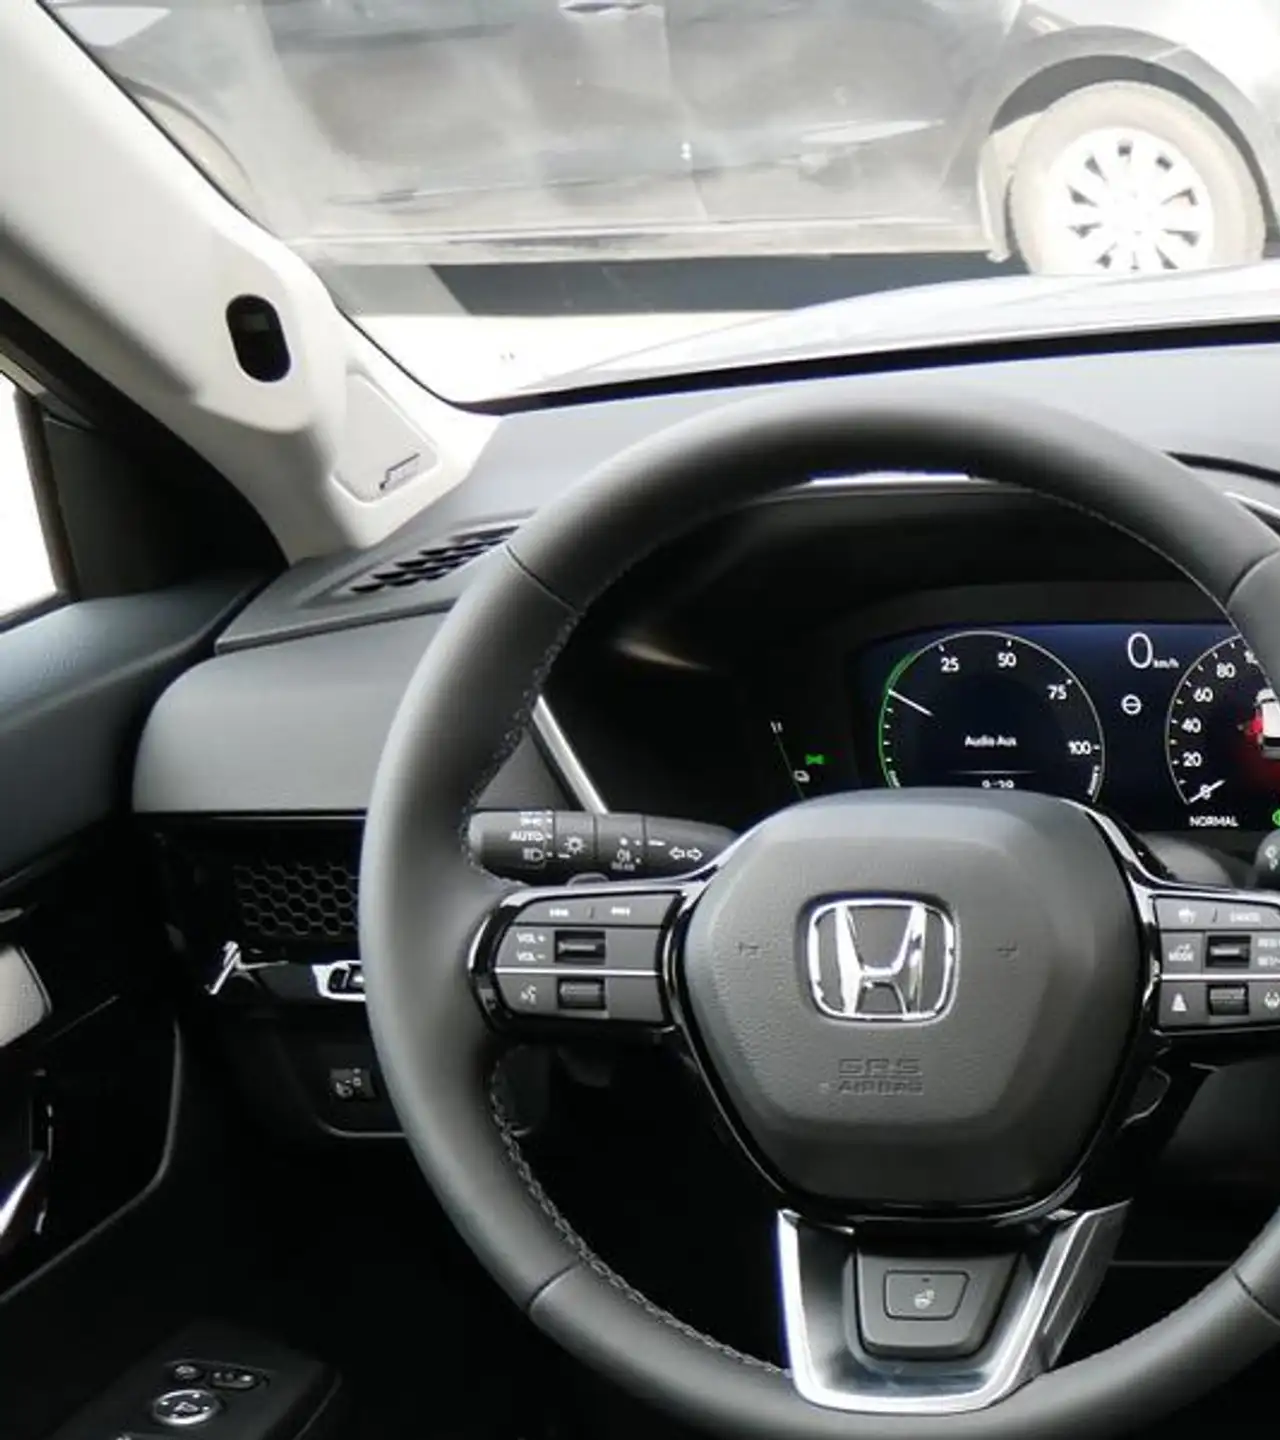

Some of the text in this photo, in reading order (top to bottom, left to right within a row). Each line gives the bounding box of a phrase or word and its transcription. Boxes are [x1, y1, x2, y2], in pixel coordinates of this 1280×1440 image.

[1127, 631, 1154, 669] 0
[940, 657, 960, 672] 25
[997, 652, 1018, 668] 50
[1216, 662, 1236, 679] 80
[1047, 683, 1068, 700] 75
[1192, 686, 1214, 702] 60
[1181, 717, 1202, 733] 40
[1067, 740, 1092, 755] 100
[1183, 751, 1202, 767] 20
[1188, 815, 1240, 827] NORMAL
